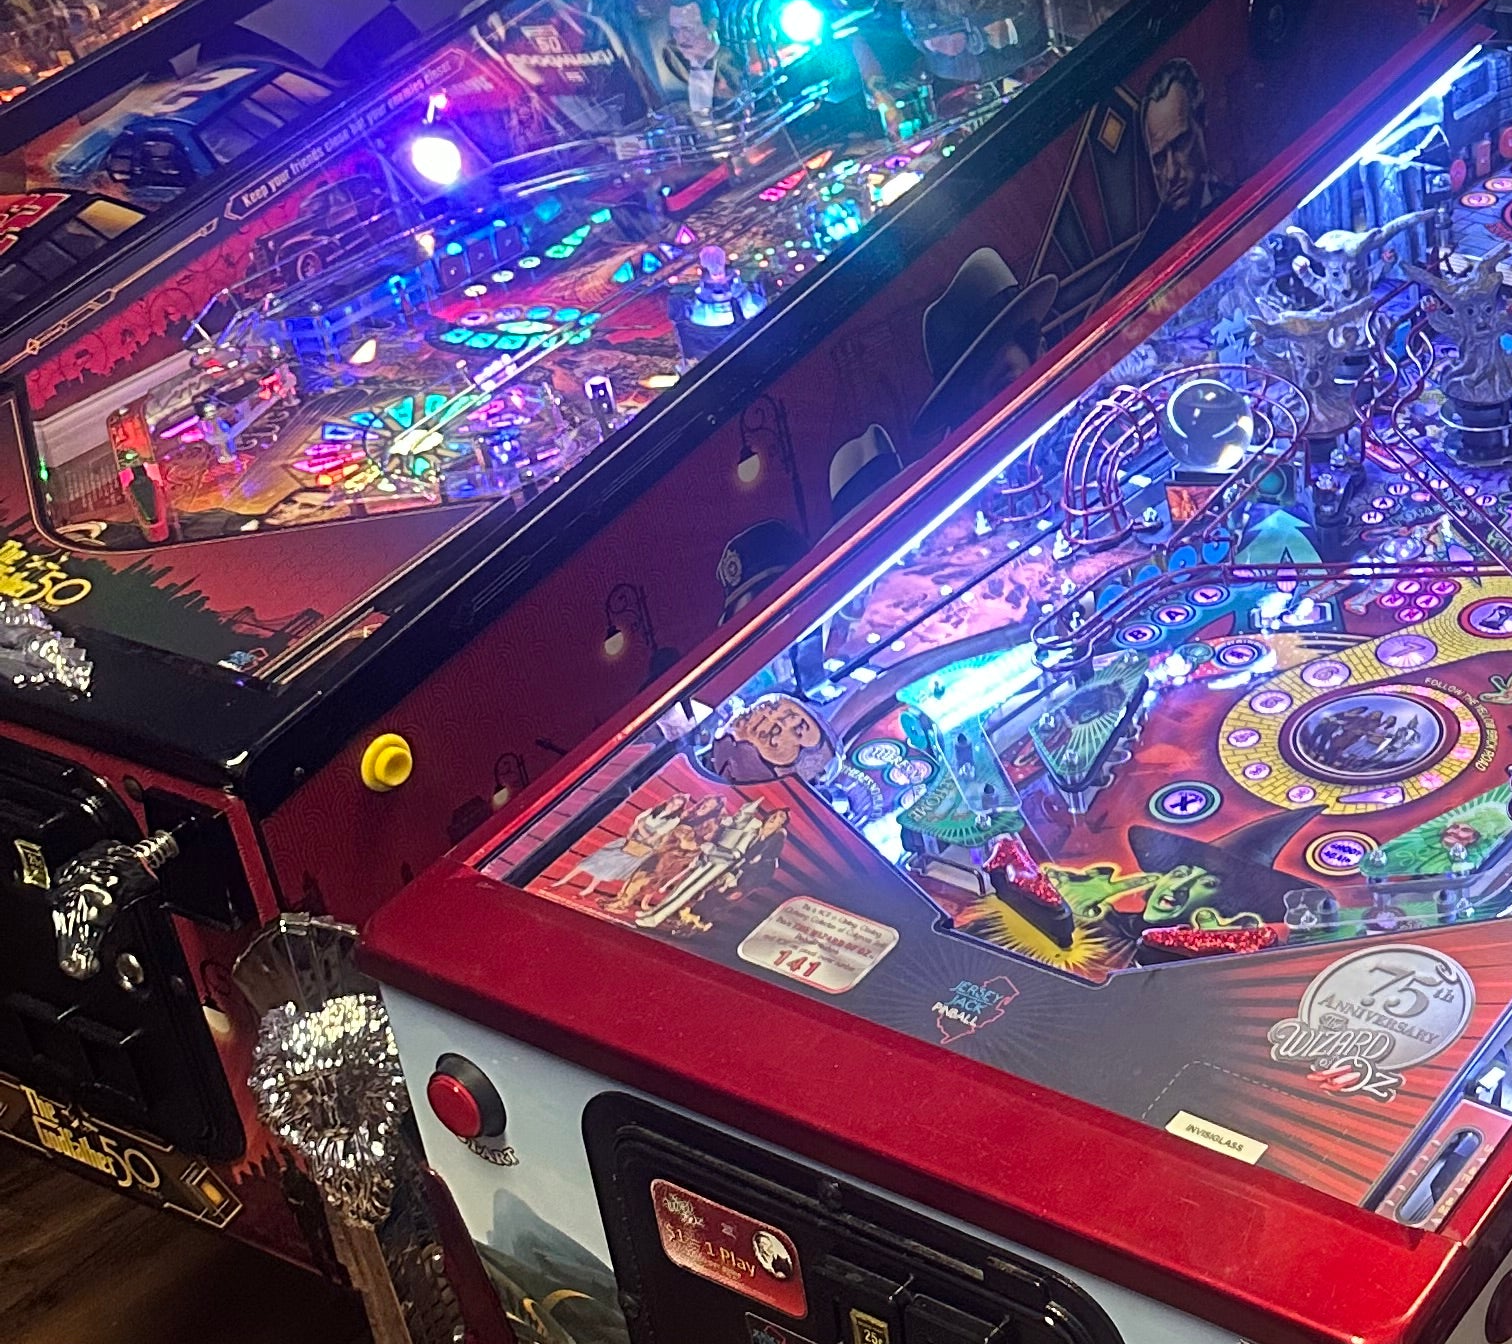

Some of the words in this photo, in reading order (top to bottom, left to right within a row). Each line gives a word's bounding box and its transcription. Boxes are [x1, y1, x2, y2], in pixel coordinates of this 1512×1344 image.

[241, 185, 269, 208] Keep
[268, 168, 290, 193] your
[289, 147, 325, 174] friends
[18, 570, 93, 605] 50
[1424, 677, 1465, 699] FOLLOW
[1475, 747, 1496, 773] ROAD
[1329, 842, 1363, 857] SHOOT
[773, 949, 822, 978] 141
[944, 994, 988, 1015] JACK
[949, 980, 1004, 1004] JERSEY
[931, 1001, 977, 1027] PINBALL
[1276, 1022, 1391, 1060] WIZARD
[19, 1084, 60, 1125] The
[32, 1114, 118, 1177] Godfather
[99, 1135, 161, 1189] 50
[1185, 1123, 1245, 1153] INVISIGLASS
[719, 1246, 757, 1278] Play
